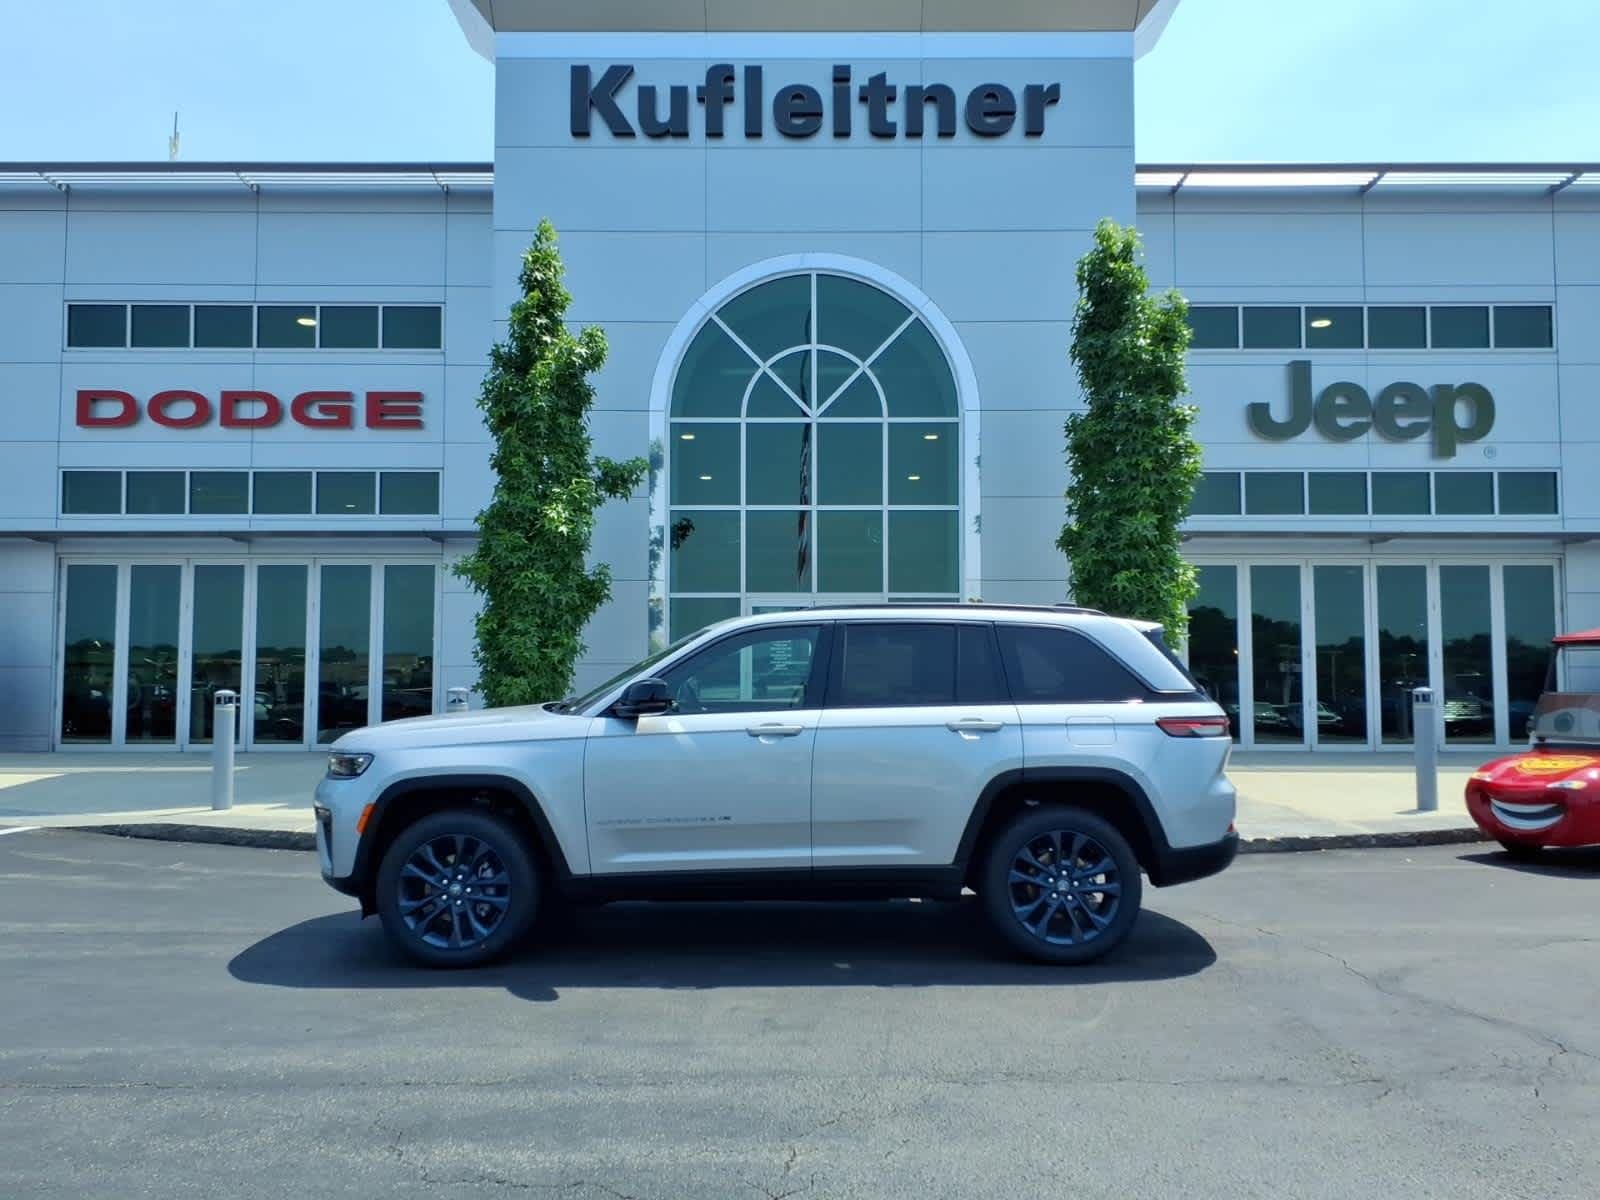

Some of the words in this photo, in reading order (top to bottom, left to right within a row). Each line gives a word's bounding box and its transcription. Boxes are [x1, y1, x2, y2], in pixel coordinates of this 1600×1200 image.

[571, 64, 1061, 138] Kufleitner
[76, 390, 424, 429] DODGE
[1248, 360, 1495, 458] Jeep
